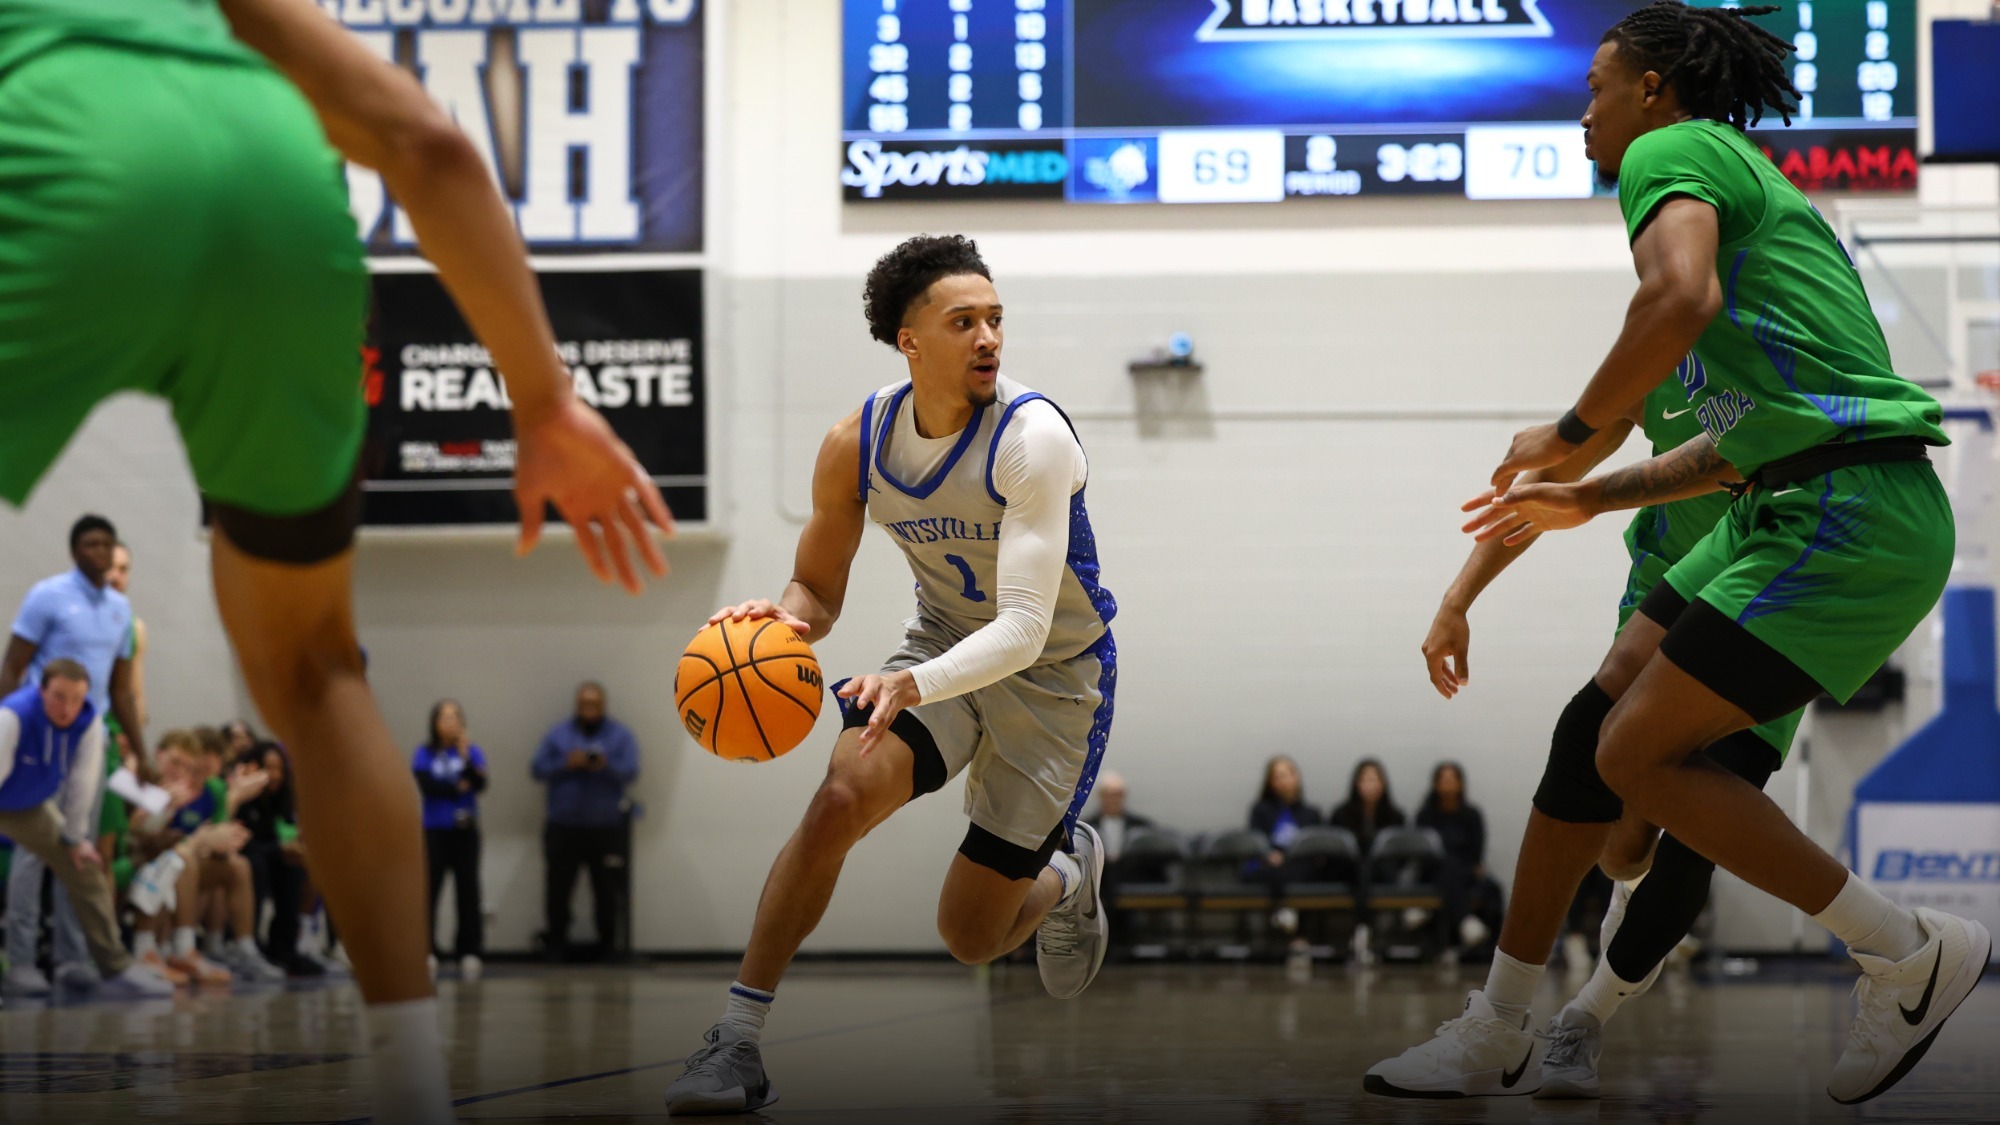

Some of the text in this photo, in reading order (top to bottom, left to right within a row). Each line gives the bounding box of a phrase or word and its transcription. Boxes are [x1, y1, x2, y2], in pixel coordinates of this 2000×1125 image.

[1195, 149, 1250, 185] 69
[1306, 135, 1337, 172] 2
[1503, 143, 1559, 179] 70
[1763, 145, 1916, 179] ABAMA
[1285, 171, 1361, 195] PERIOD
[400, 366, 513, 411] REAL
[571, 364, 692, 407] ASTE
[1696, 387, 1756, 447] RIDA
[884, 517, 1001, 543] NTSVILLE
[944, 553, 987, 602] 1
